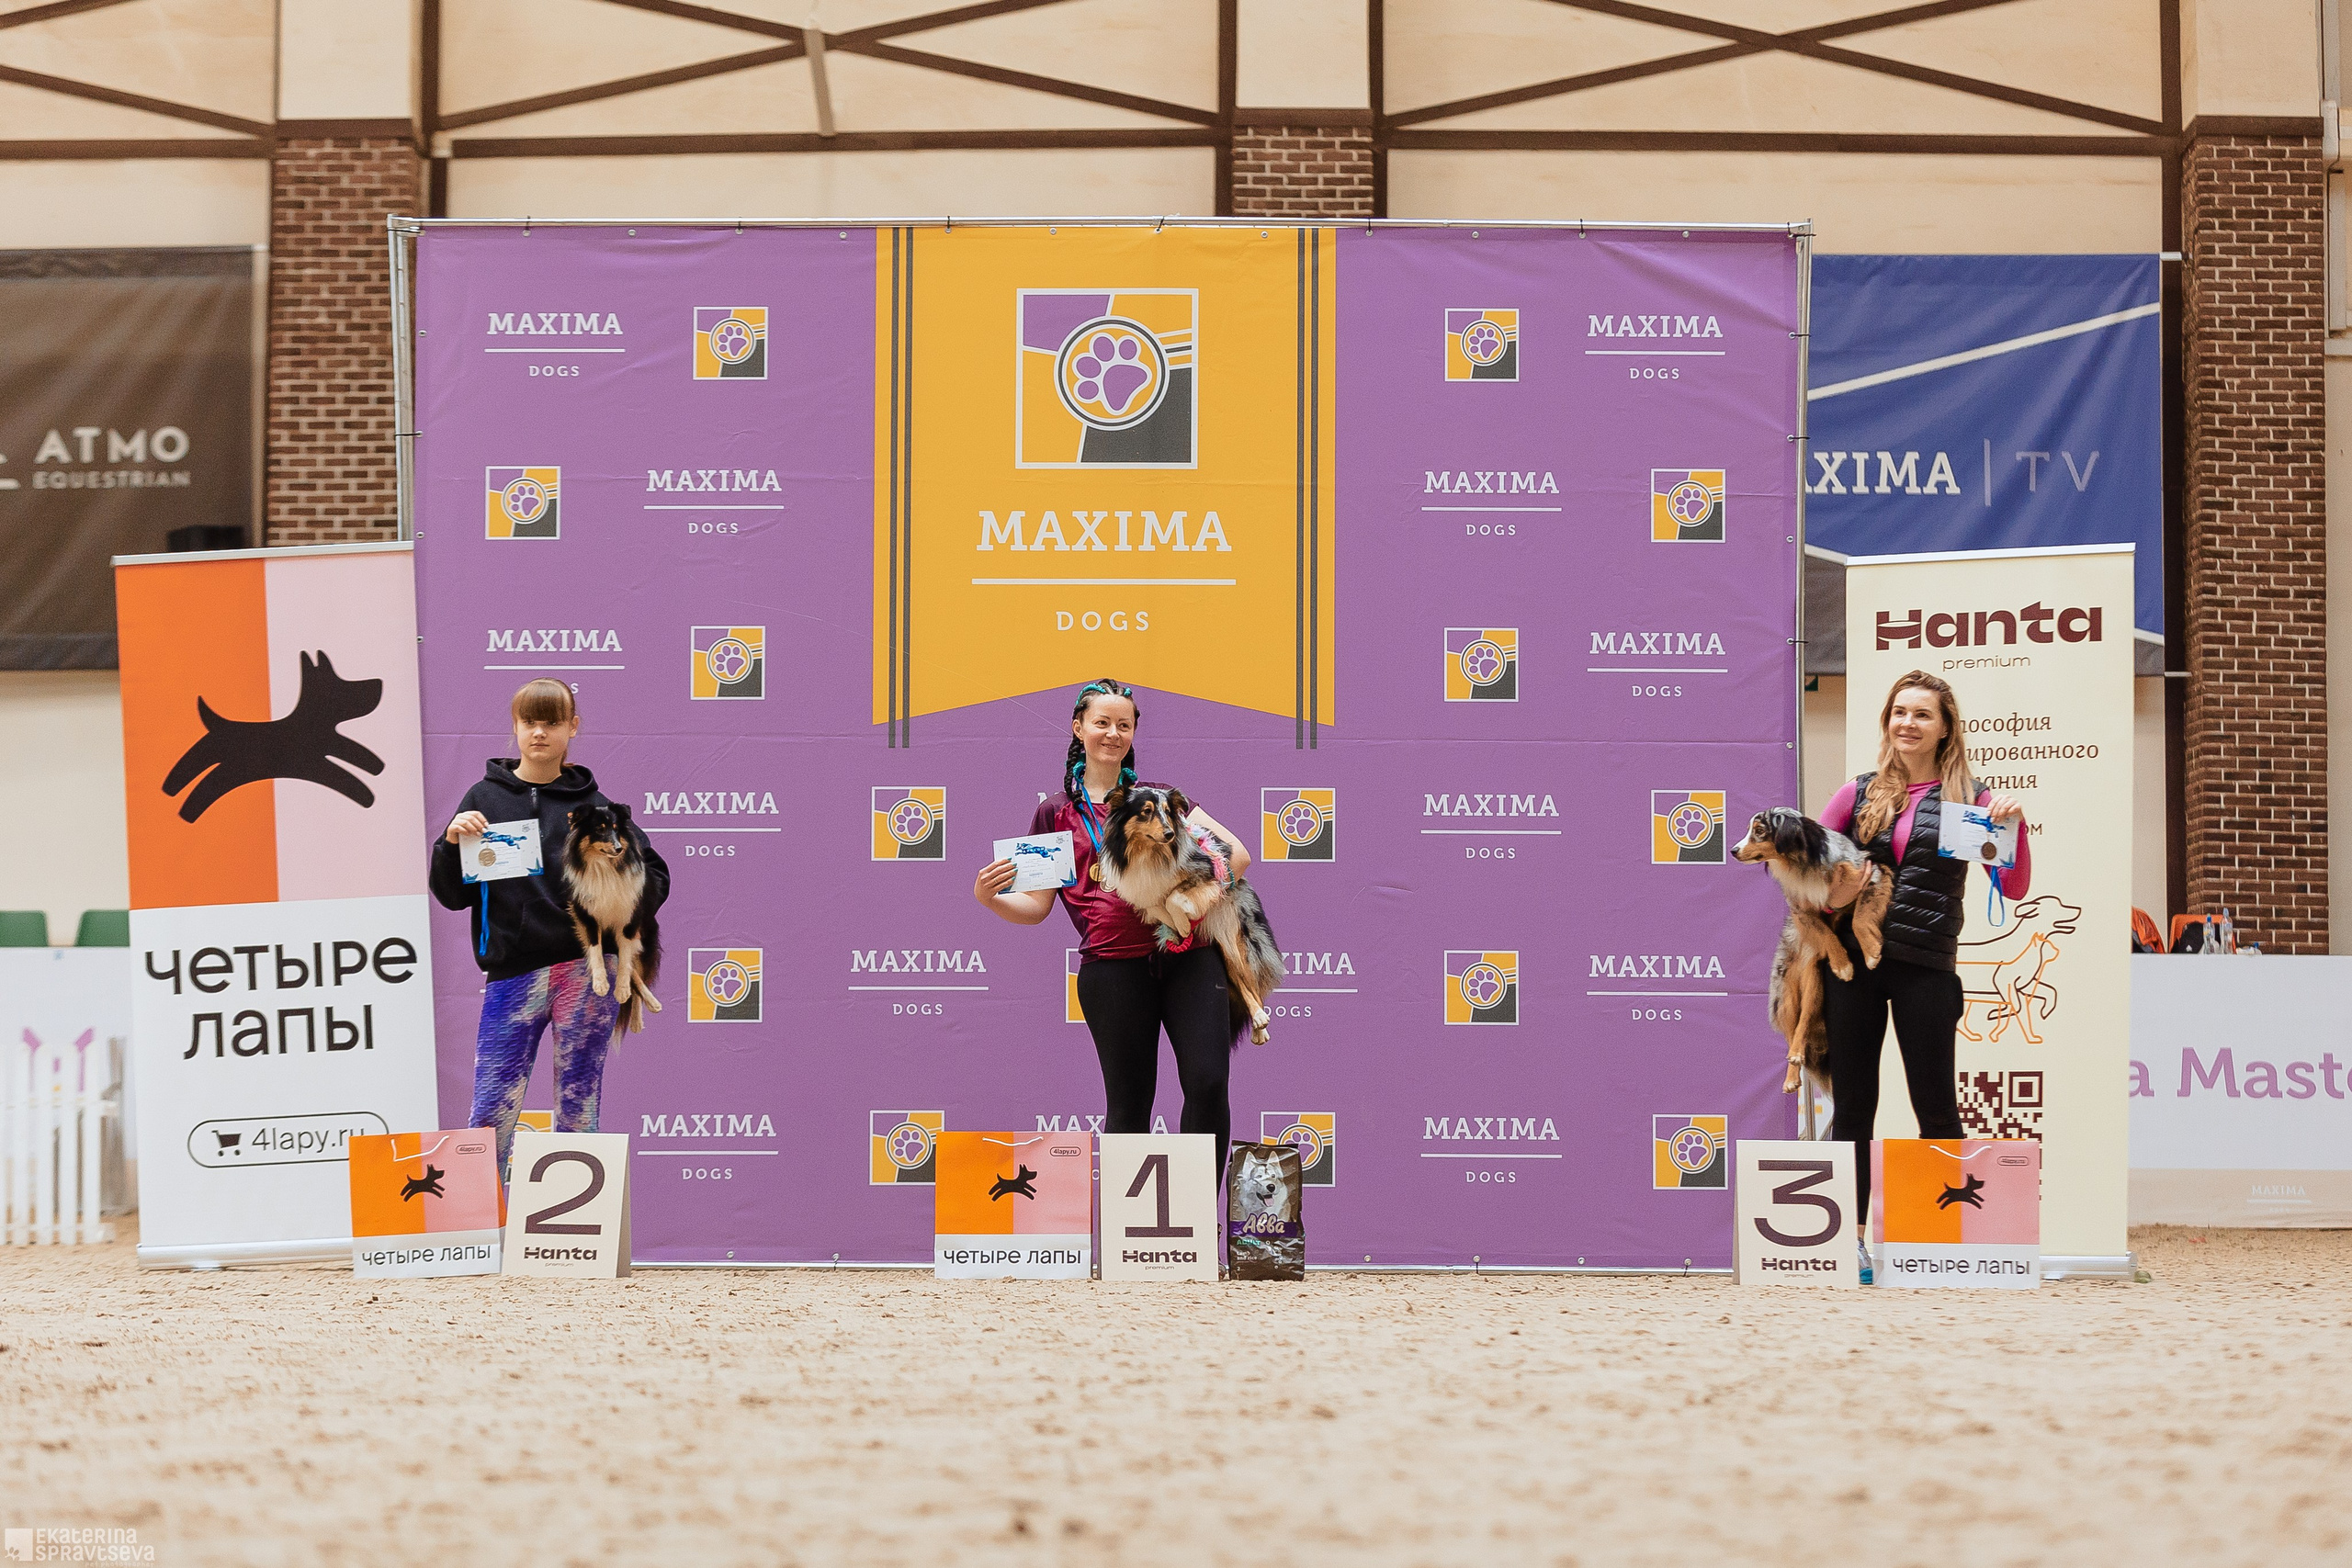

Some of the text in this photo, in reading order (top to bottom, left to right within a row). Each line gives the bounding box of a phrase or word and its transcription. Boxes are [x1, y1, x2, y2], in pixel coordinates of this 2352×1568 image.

[486, 312, 624, 335] MAXIMA
[1587, 314, 1724, 338] MAXIMA
[528, 365, 580, 377] DOGS
[1629, 367, 1679, 379] DOGS
[34, 426, 189, 464] ATMO
[32, 470, 191, 489] EQUESTRIAN
[646, 469, 783, 492] MAXIMA
[1423, 470, 1560, 494] MAXIMA
[1804, 451, 2099, 494] XIMA TV
[687, 522, 739, 534] DOGS
[977, 511, 1232, 552] MAXIMA
[1465, 524, 1516, 536] DOGS
[1057, 611, 1149, 631] DOGS
[1875, 600, 2102, 651] Hanta
[486, 629, 623, 652] MAXIMA
[1589, 632, 1726, 655] MAXIMA
[1942, 654, 2030, 671] premium
[1632, 685, 1682, 697] DOGS
[1959, 712, 2052, 737] ософия
[1966, 744, 2098, 766] ированного
[1976, 774, 2038, 789] ания
[643, 792, 780, 815] MAXIMA
[1422, 794, 1560, 817] MAXIMA
[684, 845, 735, 857] DOGS
[1465, 847, 1516, 859] DOGS
[145, 937, 417, 995] четыре
[850, 950, 987, 973] MAXIMA
[1282, 952, 1356, 975] IMA
[1589, 954, 1726, 978] MAXIMA
[892, 1003, 943, 1015] DOGS
[1631, 1009, 1682, 1021] DOGS
[184, 1004, 375, 1060] лапы
[2177, 1046, 2352, 1100] Mast
[639, 1114, 776, 1137] MAXIMA
[1422, 1117, 1560, 1141] MAXIMA
[682, 1168, 733, 1180] DOGS
[1465, 1171, 1516, 1183] DOGS
[525, 1150, 605, 1235] 2
[1125, 1154, 1194, 1237] 1
[1754, 1159, 1842, 1247] 3
[361, 1245, 492, 1267] четыре лапы
[524, 1247, 597, 1260] Hanta
[944, 1247, 1081, 1264] четыре лапы
[1123, 1249, 1197, 1263] Hanta
[1761, 1258, 1837, 1271] Hanta
[1893, 1258, 2030, 1275] четыре лапы
